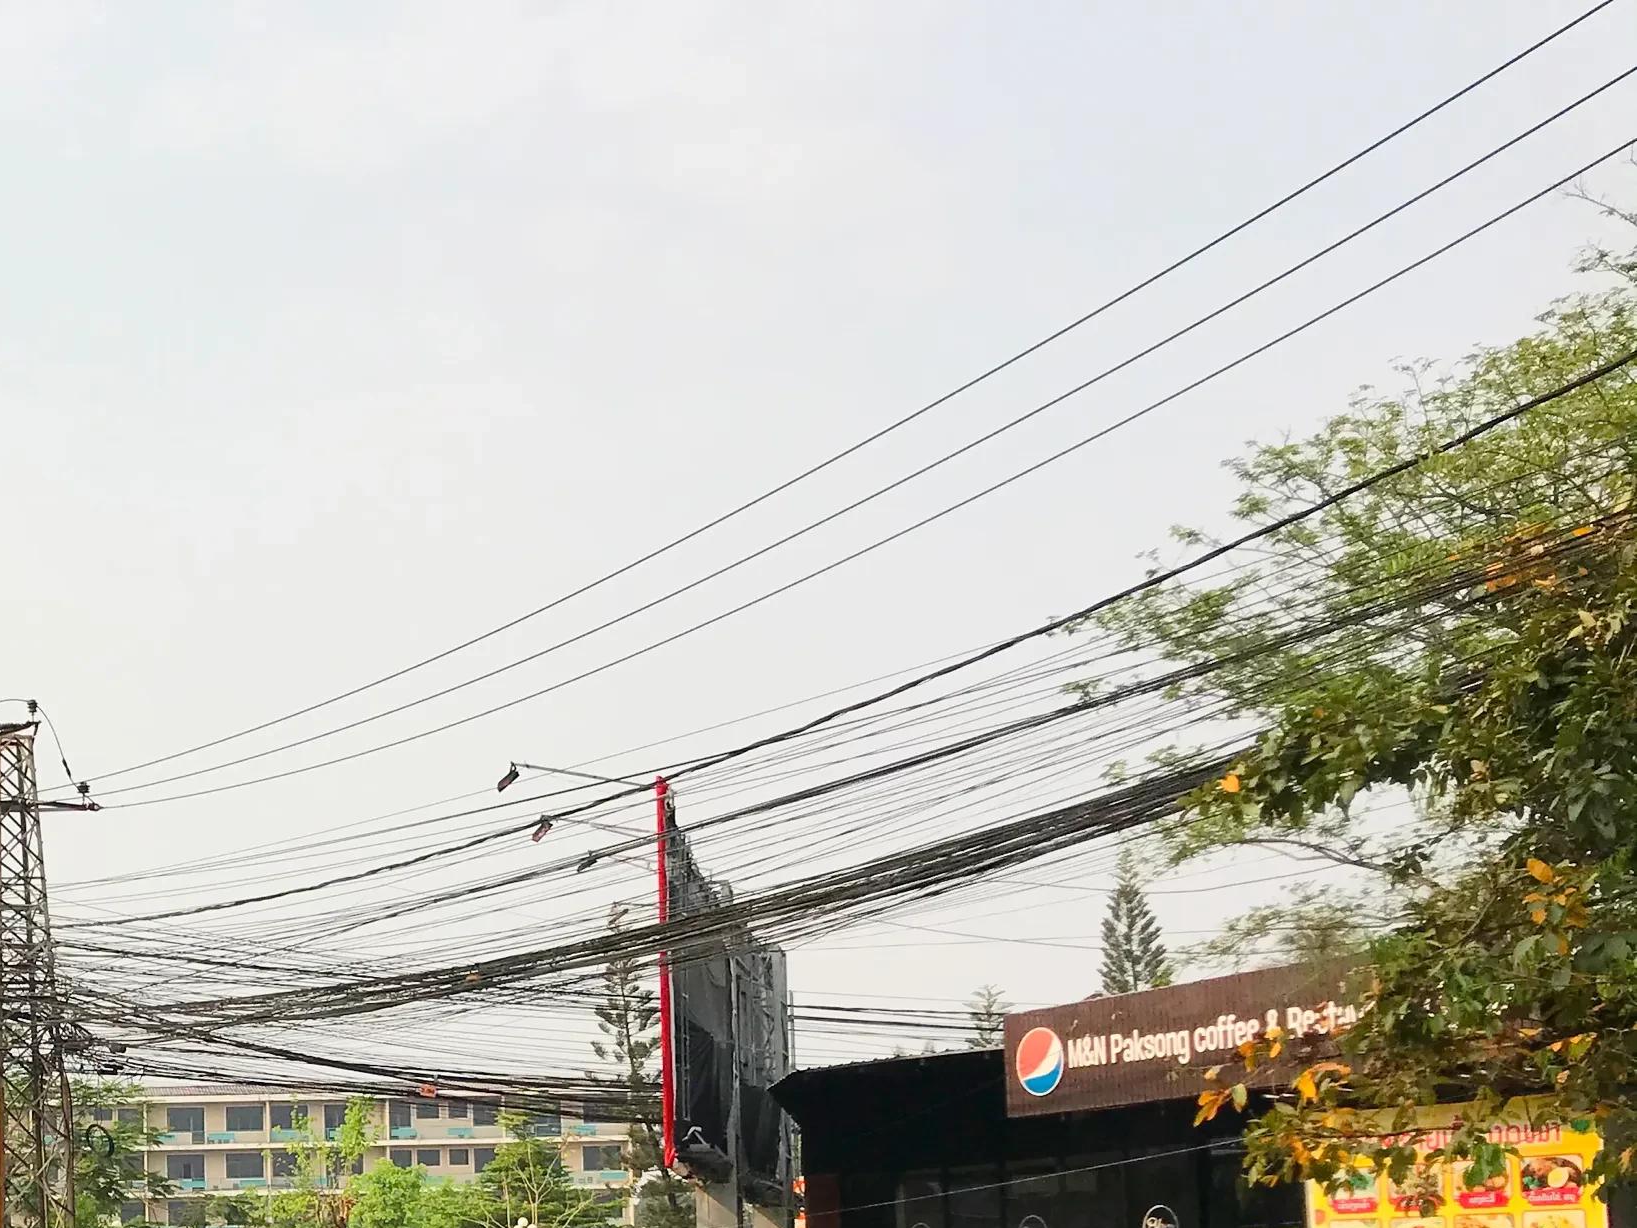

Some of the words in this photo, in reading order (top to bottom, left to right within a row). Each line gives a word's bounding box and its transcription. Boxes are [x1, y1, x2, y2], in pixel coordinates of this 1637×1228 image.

[1067, 1033, 1107, 1069] M&N
[1110, 1029, 1191, 1064] Paksong
[1193, 1014, 1260, 1053] coffee
